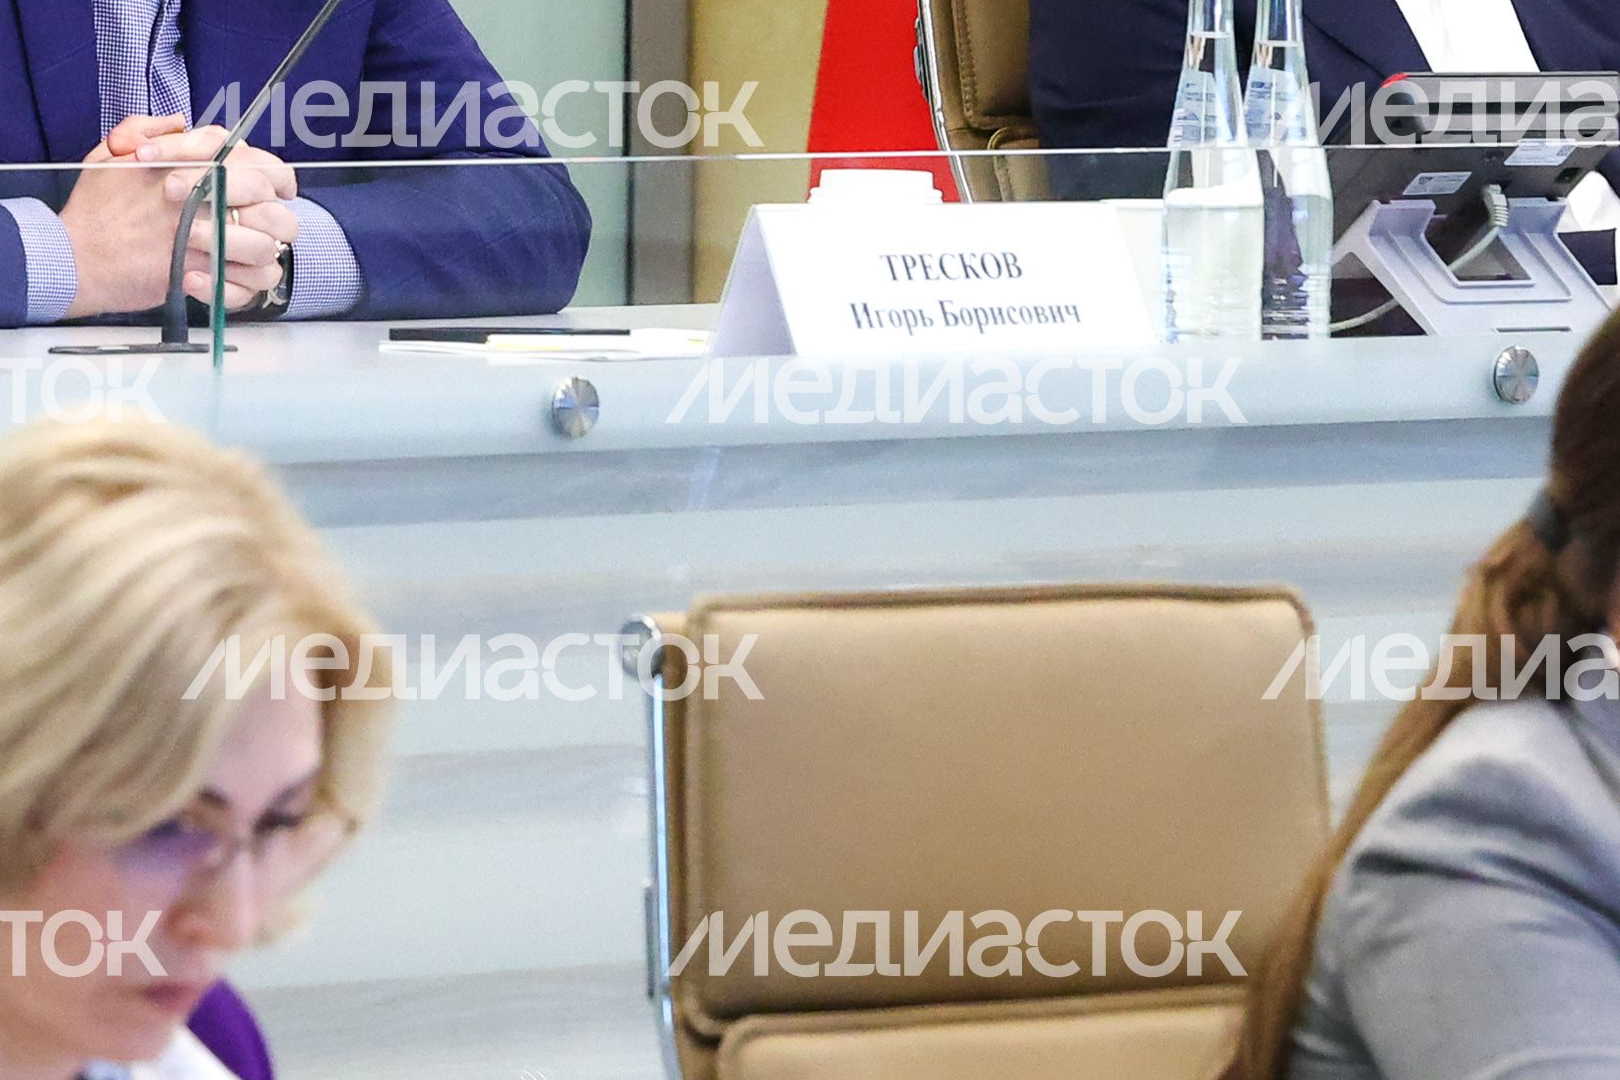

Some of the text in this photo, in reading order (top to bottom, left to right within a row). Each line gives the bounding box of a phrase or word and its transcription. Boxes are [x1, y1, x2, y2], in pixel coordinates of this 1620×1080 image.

[879, 251, 1023, 282] ТРЕСКОВ
[849, 300, 1081, 336] Игорь Борисович
